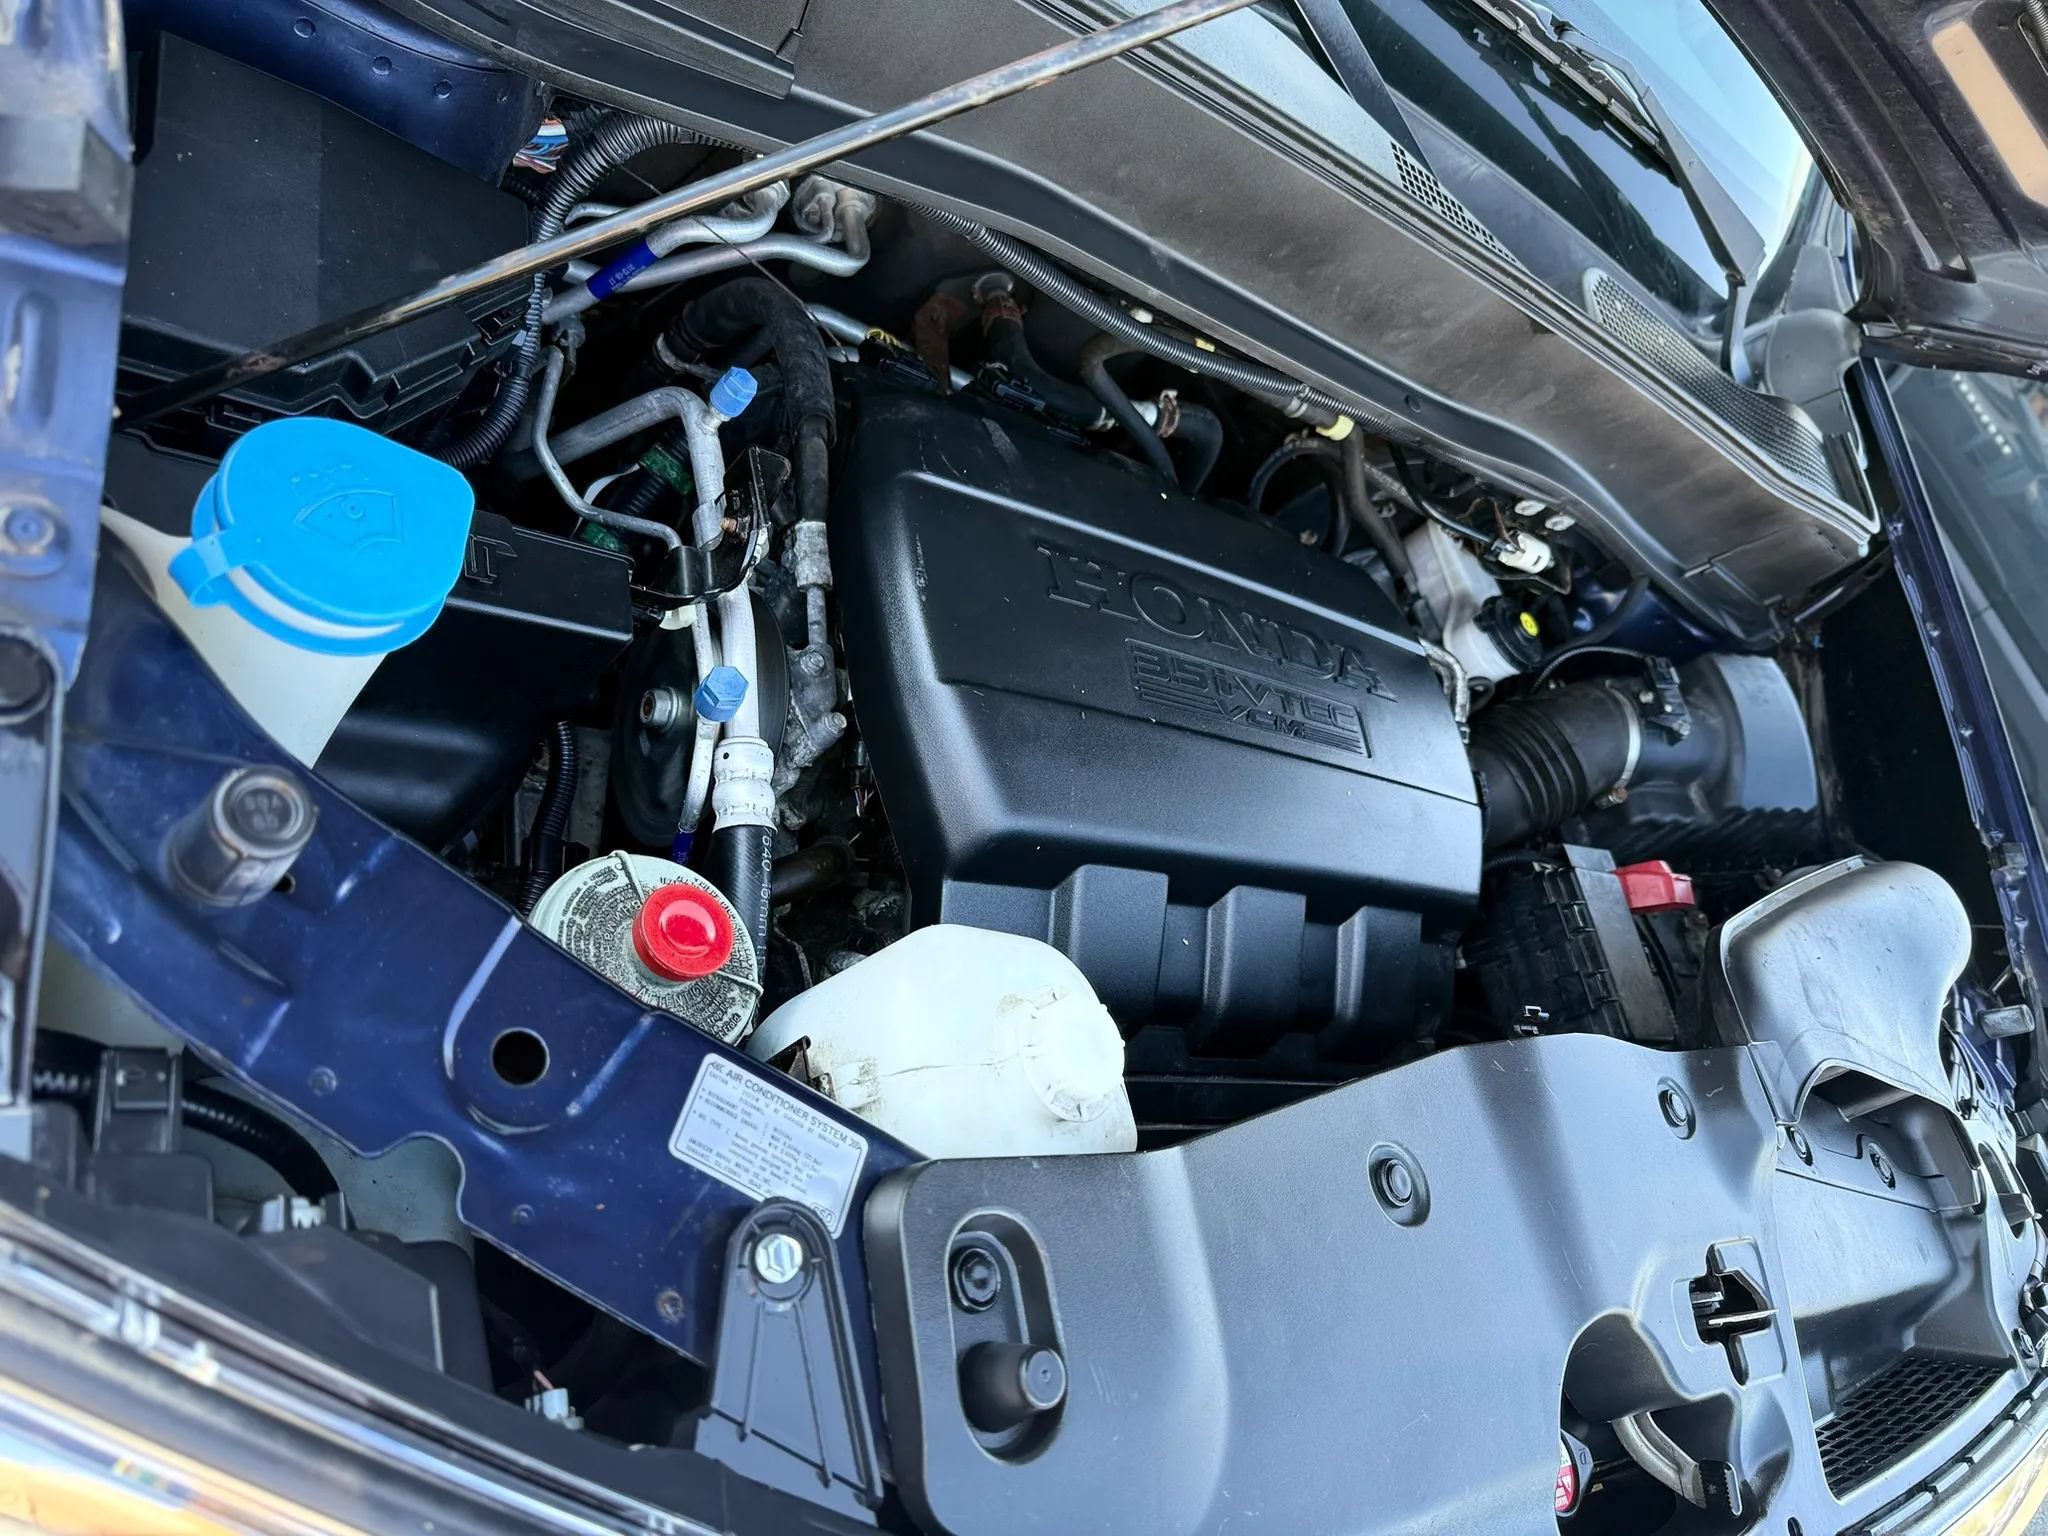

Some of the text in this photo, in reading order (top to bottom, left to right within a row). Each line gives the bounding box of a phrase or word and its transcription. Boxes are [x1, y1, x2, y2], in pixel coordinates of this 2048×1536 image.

[1037, 545, 1399, 702] HONDA
[725, 1068, 745, 1086] AIR
[744, 1077, 809, 1121] CONDITIONER
[811, 1116, 849, 1143] SYSTEM
